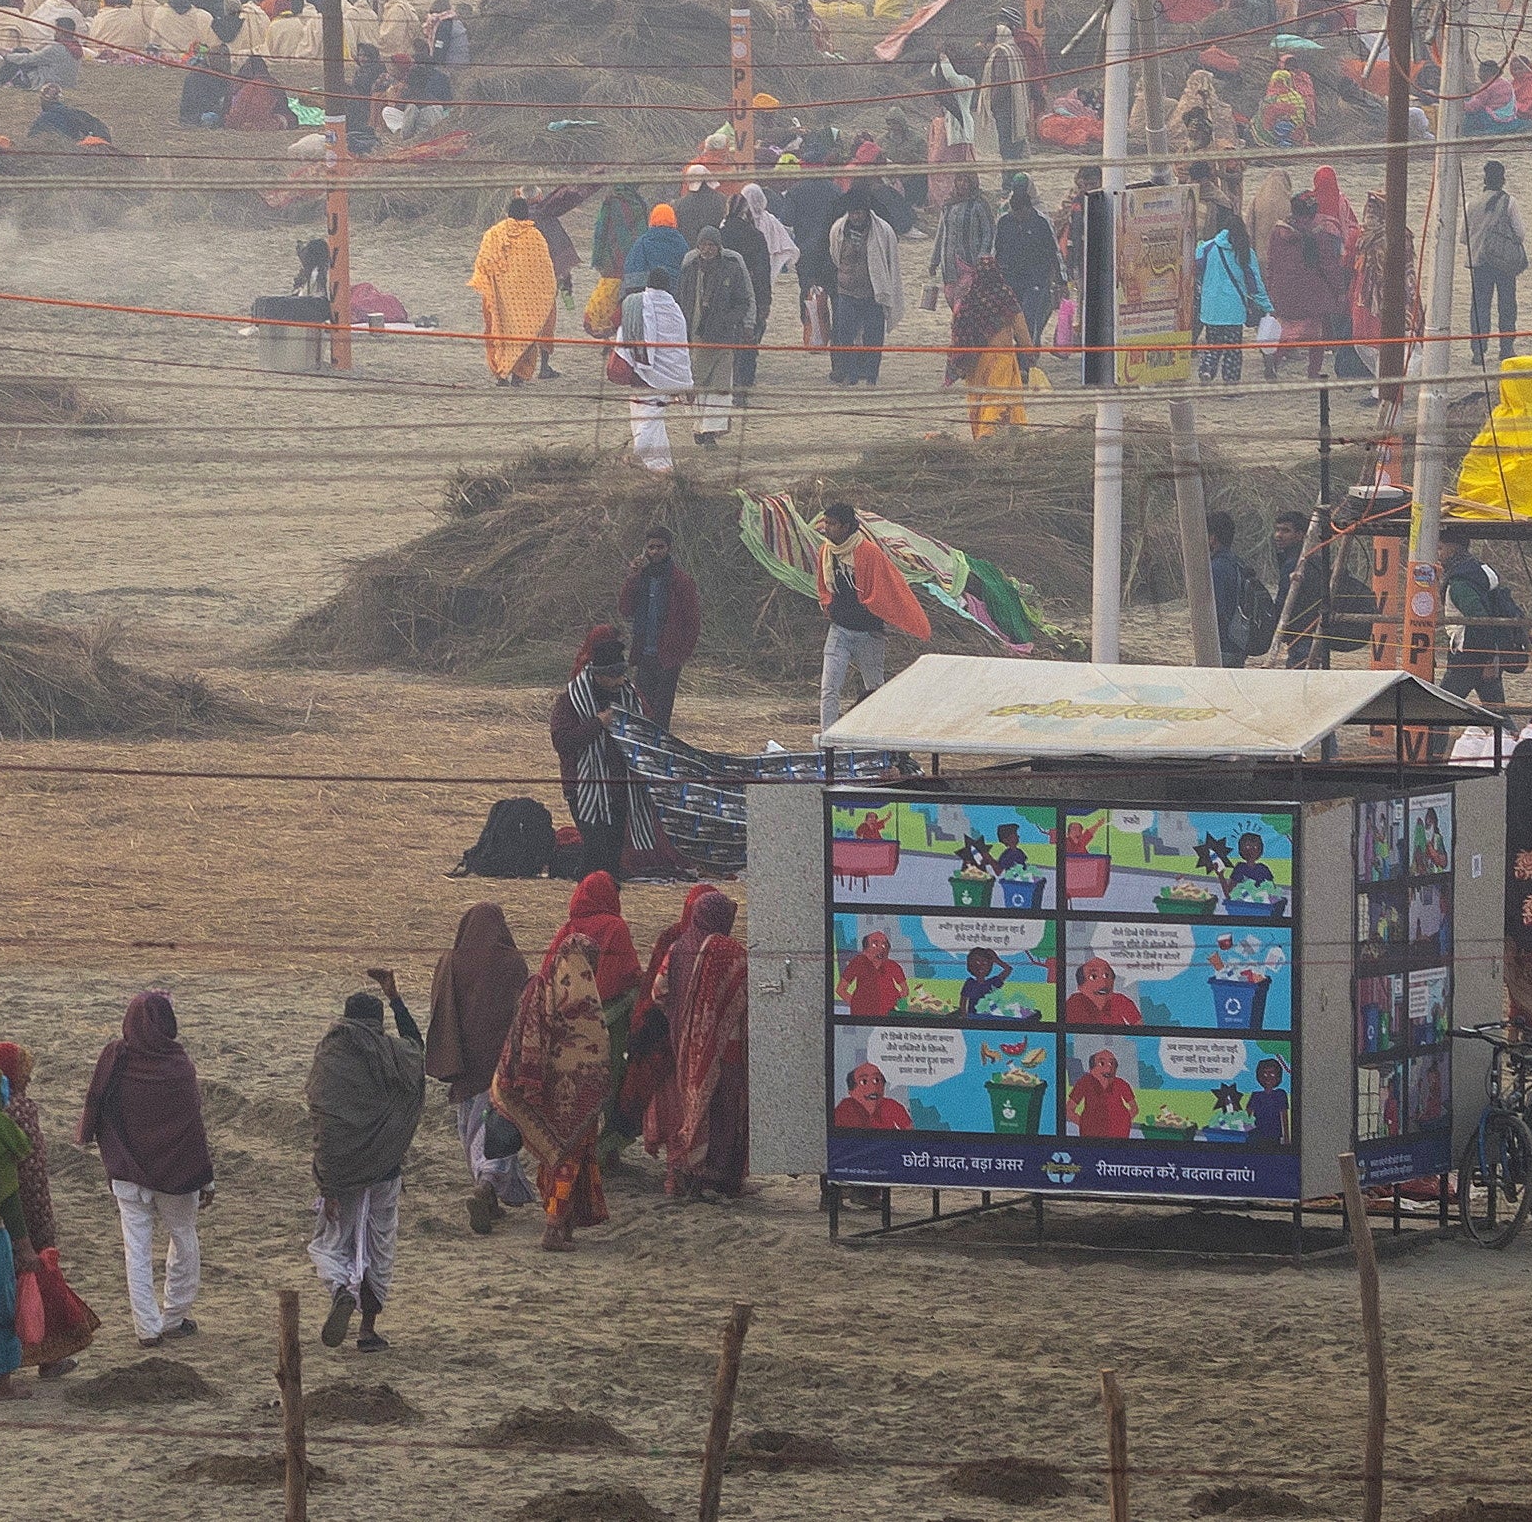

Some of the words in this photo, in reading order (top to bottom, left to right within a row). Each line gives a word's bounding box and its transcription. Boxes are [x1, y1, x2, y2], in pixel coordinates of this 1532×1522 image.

[901, 1151, 930, 1168] छोटी
[932, 1156, 969, 1170] आदत,
[970, 1158, 993, 1173] बड़ा
[994, 1158, 1024, 1171] असर
[1096, 1160, 1154, 1179] रीसायकल
[1157, 1162, 1180, 1181] करें,
[1181, 1167, 1223, 1182] बदलाव
[1226, 1166, 1255, 1183] लाएं।
